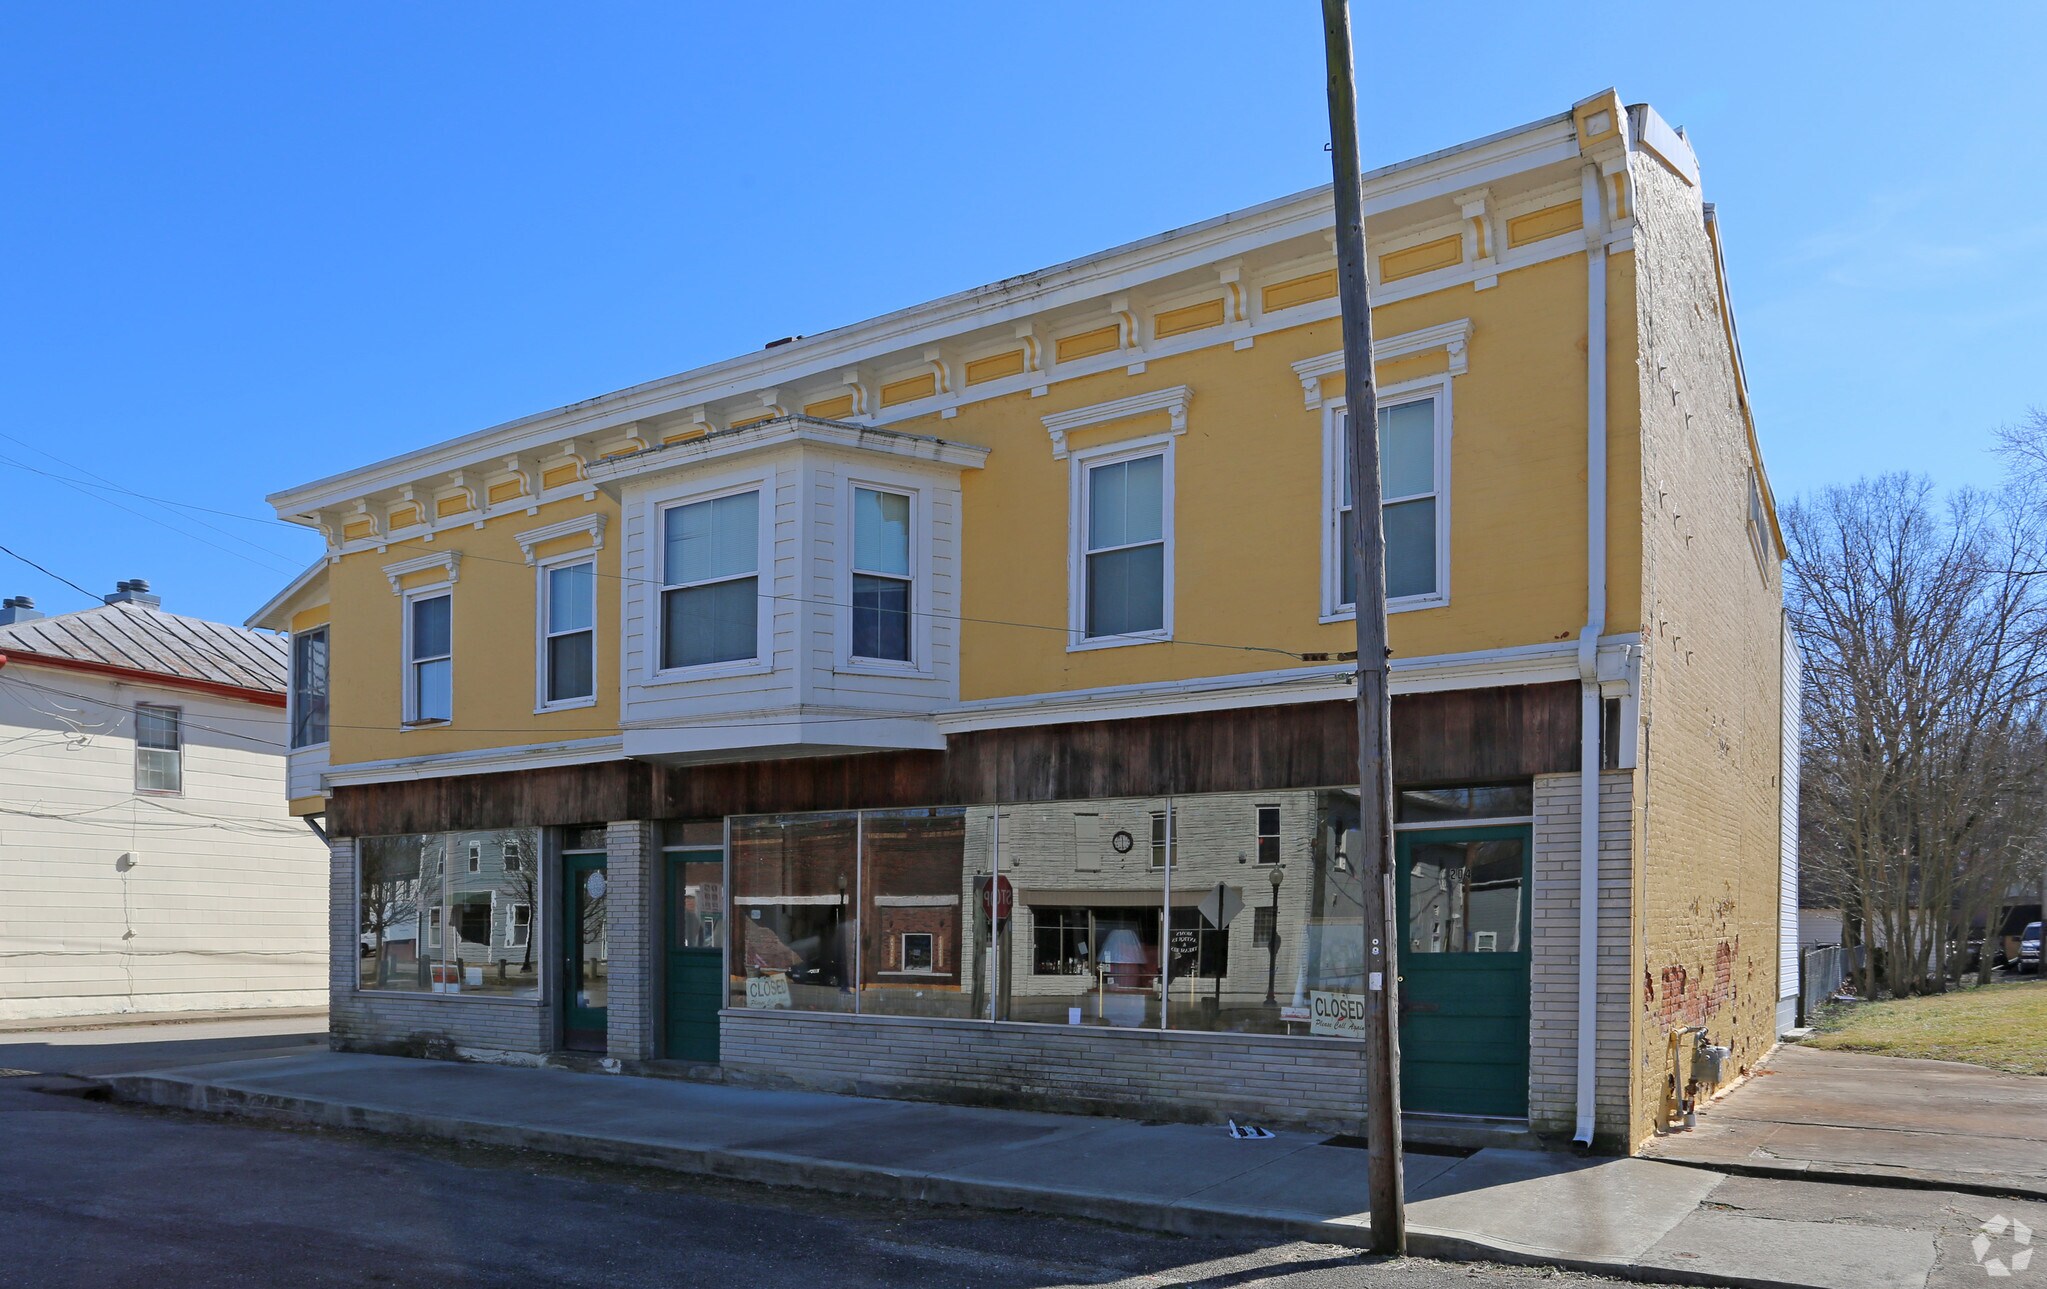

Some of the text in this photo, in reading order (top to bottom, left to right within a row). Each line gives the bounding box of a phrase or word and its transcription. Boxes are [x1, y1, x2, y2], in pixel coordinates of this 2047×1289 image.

[1450, 869, 1471, 880] 204
[750, 979, 786, 998] CLOSED
[1315, 997, 1365, 1020] CLOSED
[1315, 1019, 1332, 1028] Please
[1333, 1021, 1347, 1030] Call
